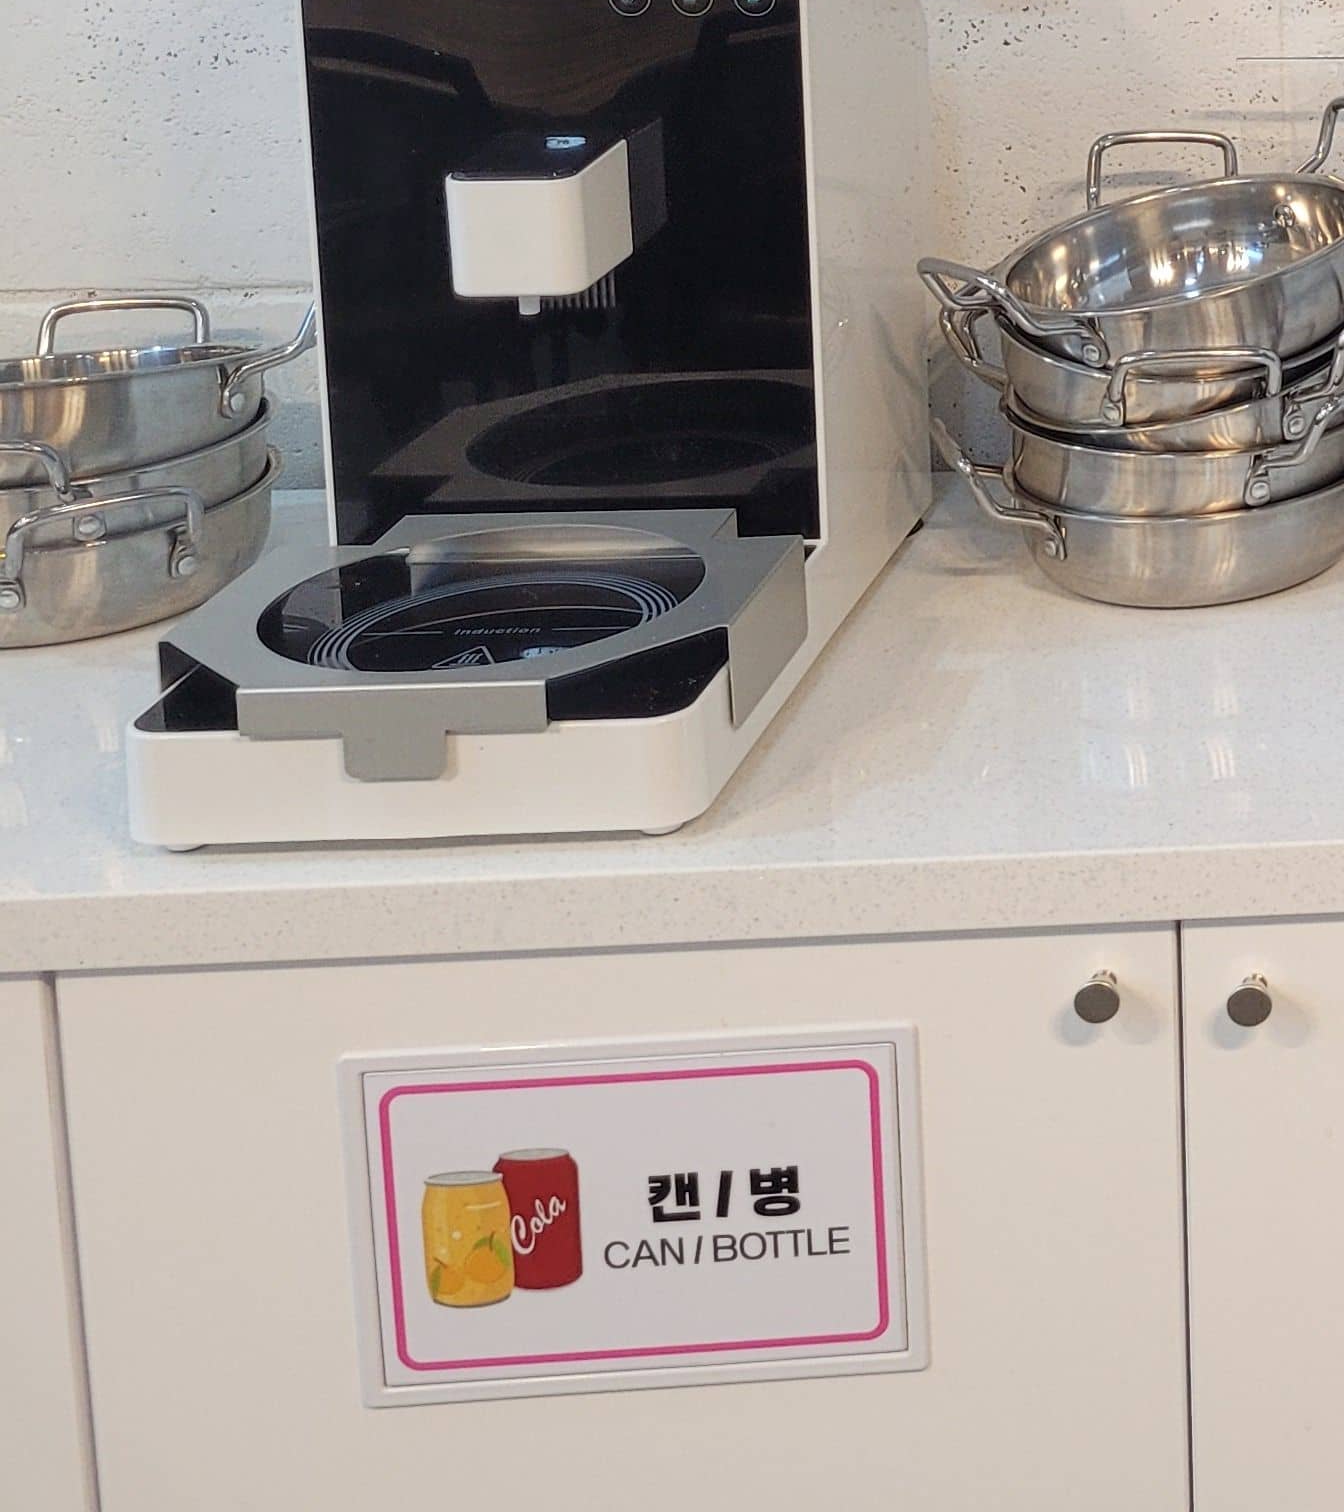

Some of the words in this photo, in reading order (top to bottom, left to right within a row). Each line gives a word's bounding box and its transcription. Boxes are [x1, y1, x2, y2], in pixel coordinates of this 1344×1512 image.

[648, 1171, 701, 1223] 캔
[750, 1166, 801, 1218] 병
[510, 1193, 567, 1256] Cola
[603, 1239, 685, 1270] CAN
[712, 1226, 851, 1264] BOTTLE
